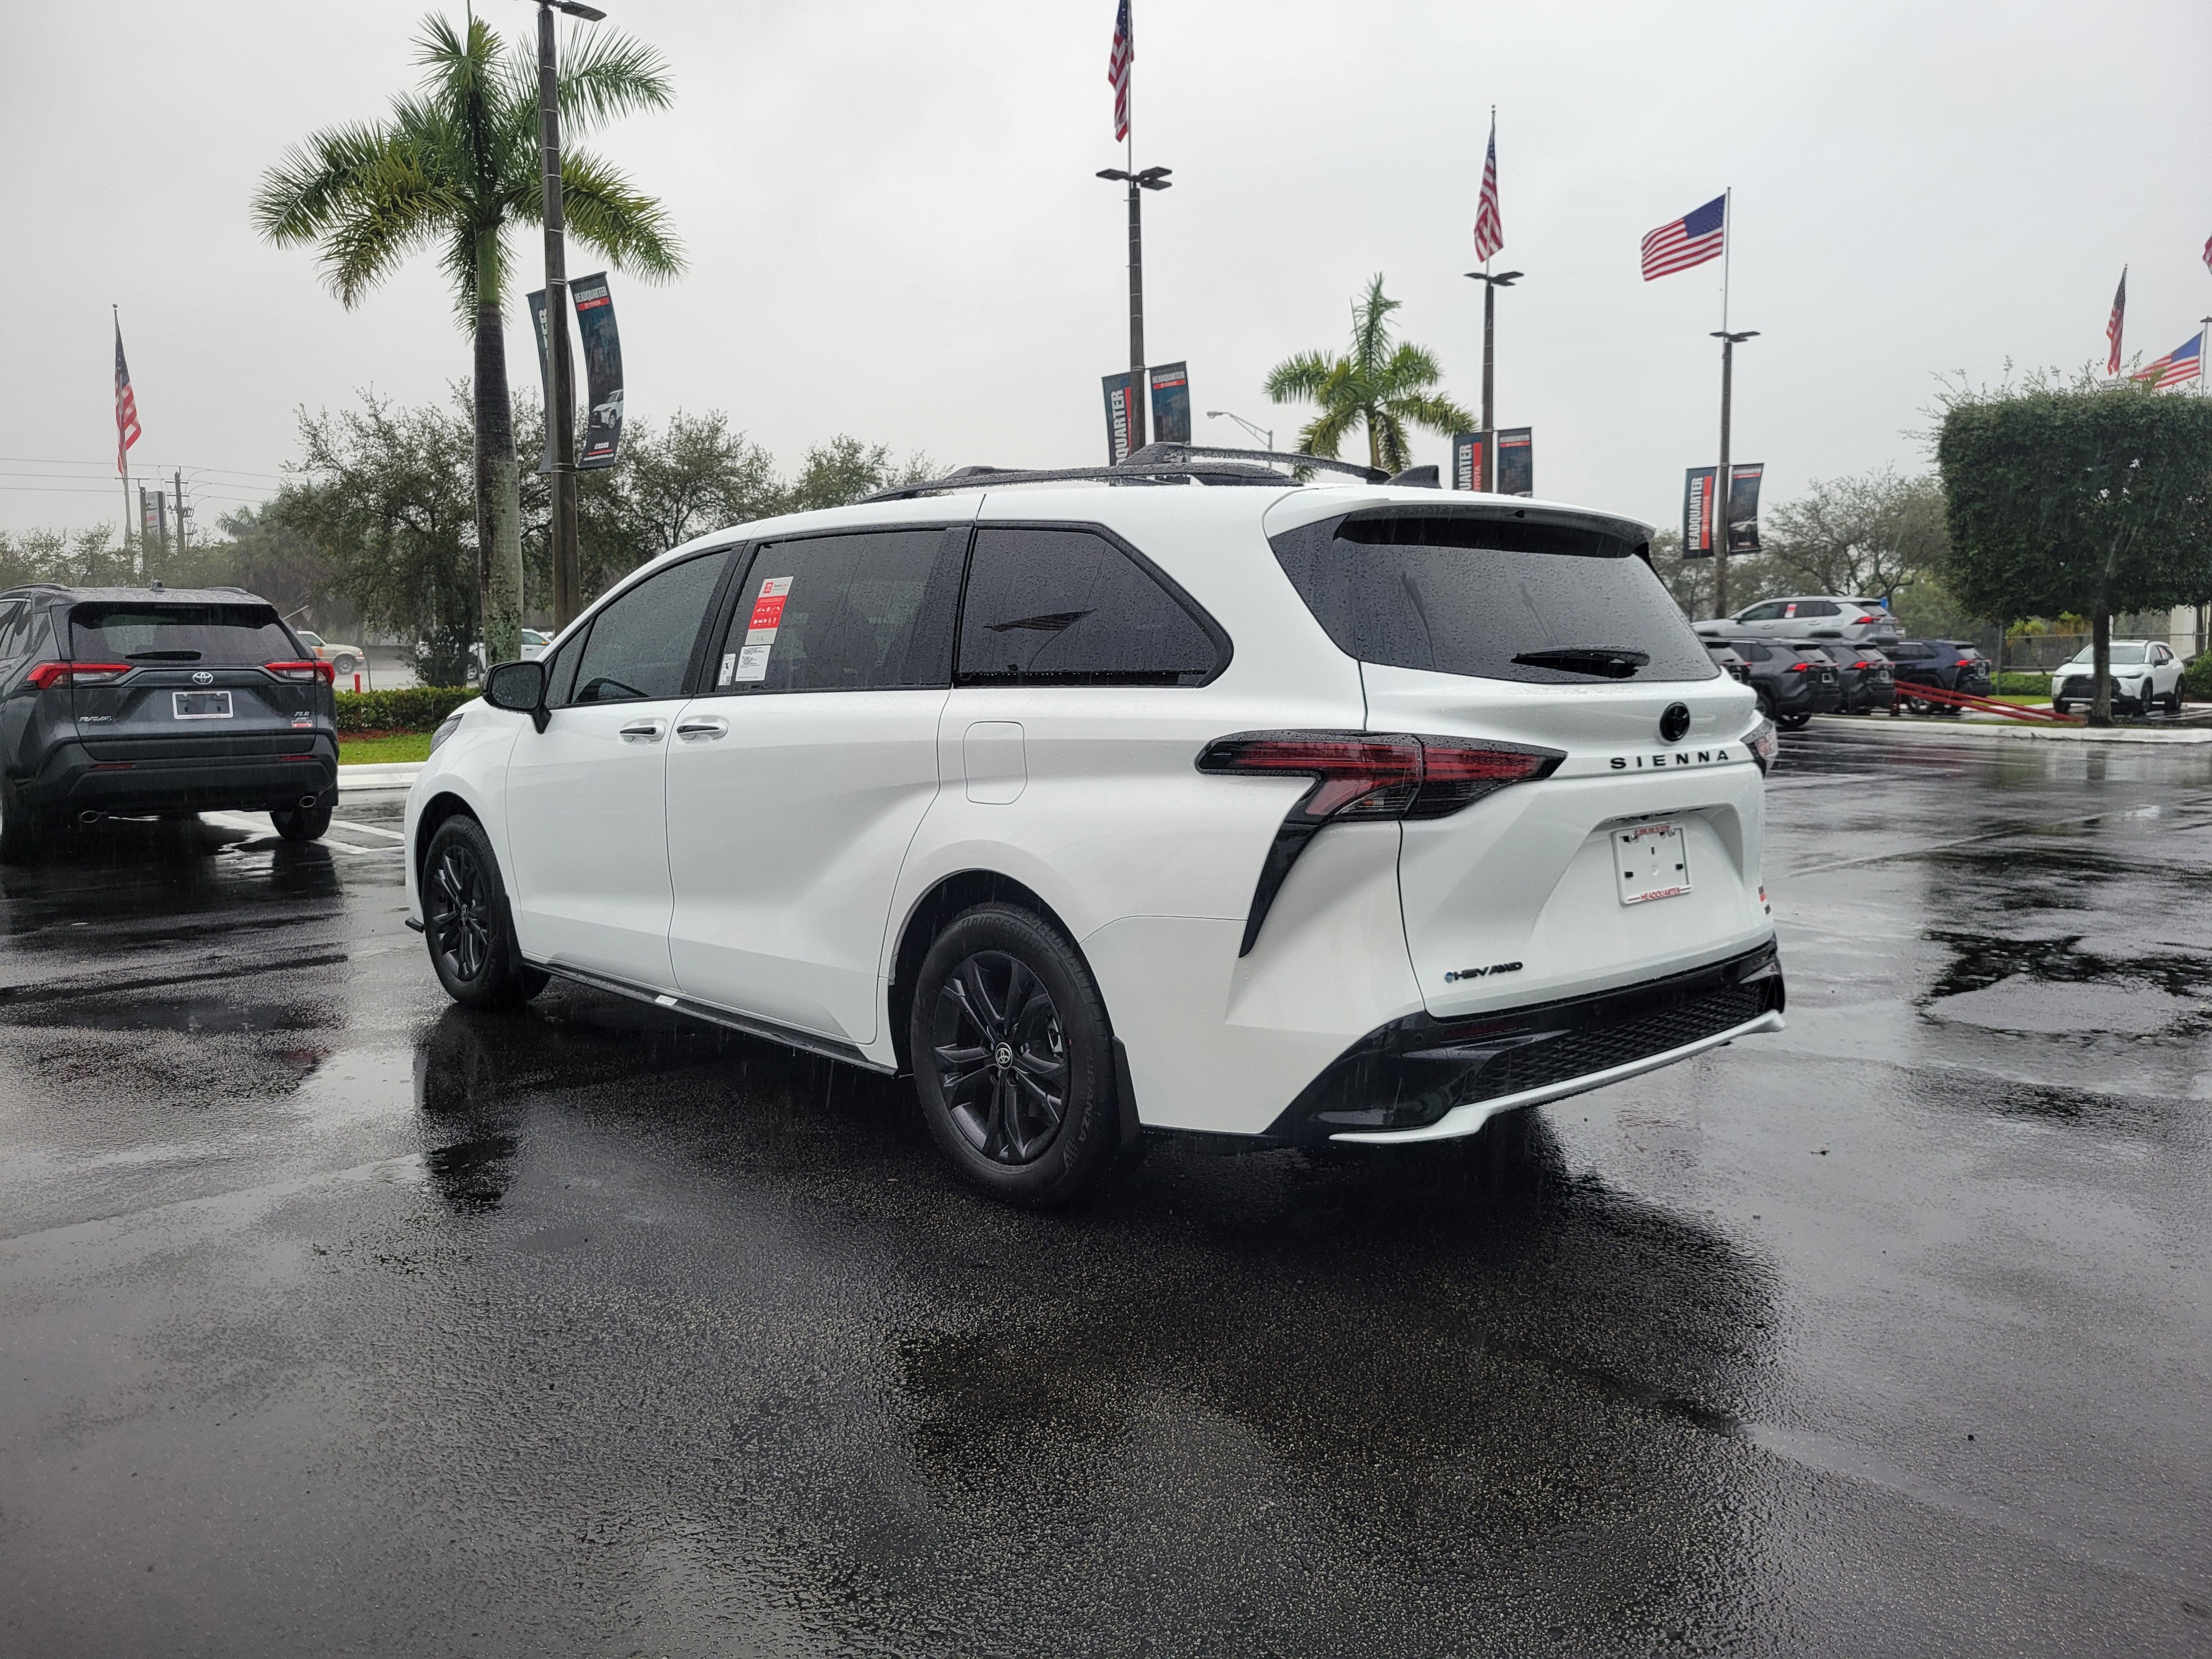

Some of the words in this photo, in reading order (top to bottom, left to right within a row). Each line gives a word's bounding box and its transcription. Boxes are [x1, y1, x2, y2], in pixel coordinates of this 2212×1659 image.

[1110, 389, 1129, 466] QUARTER
[1458, 443, 1472, 491] UARTER
[1688, 476, 1704, 550] HEADQUARTER
[1610, 749, 1729, 769] SIENNA
[1640, 887, 1680, 901] HEADQUARTER
